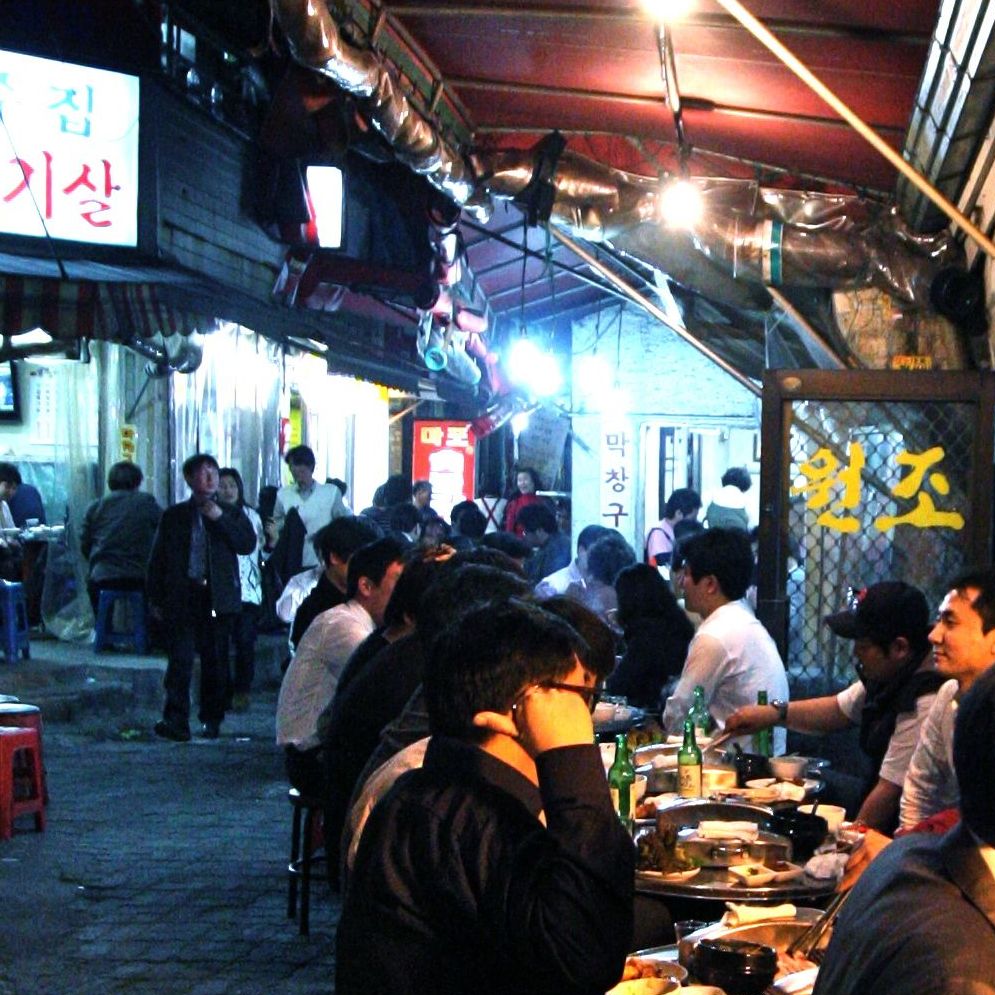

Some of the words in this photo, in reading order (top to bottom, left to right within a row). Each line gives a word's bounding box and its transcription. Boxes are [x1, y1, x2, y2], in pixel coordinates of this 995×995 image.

[3, 150, 121, 228] 기살
[602, 431, 630, 528] 막창구
[790, 440, 965, 534] 원조
